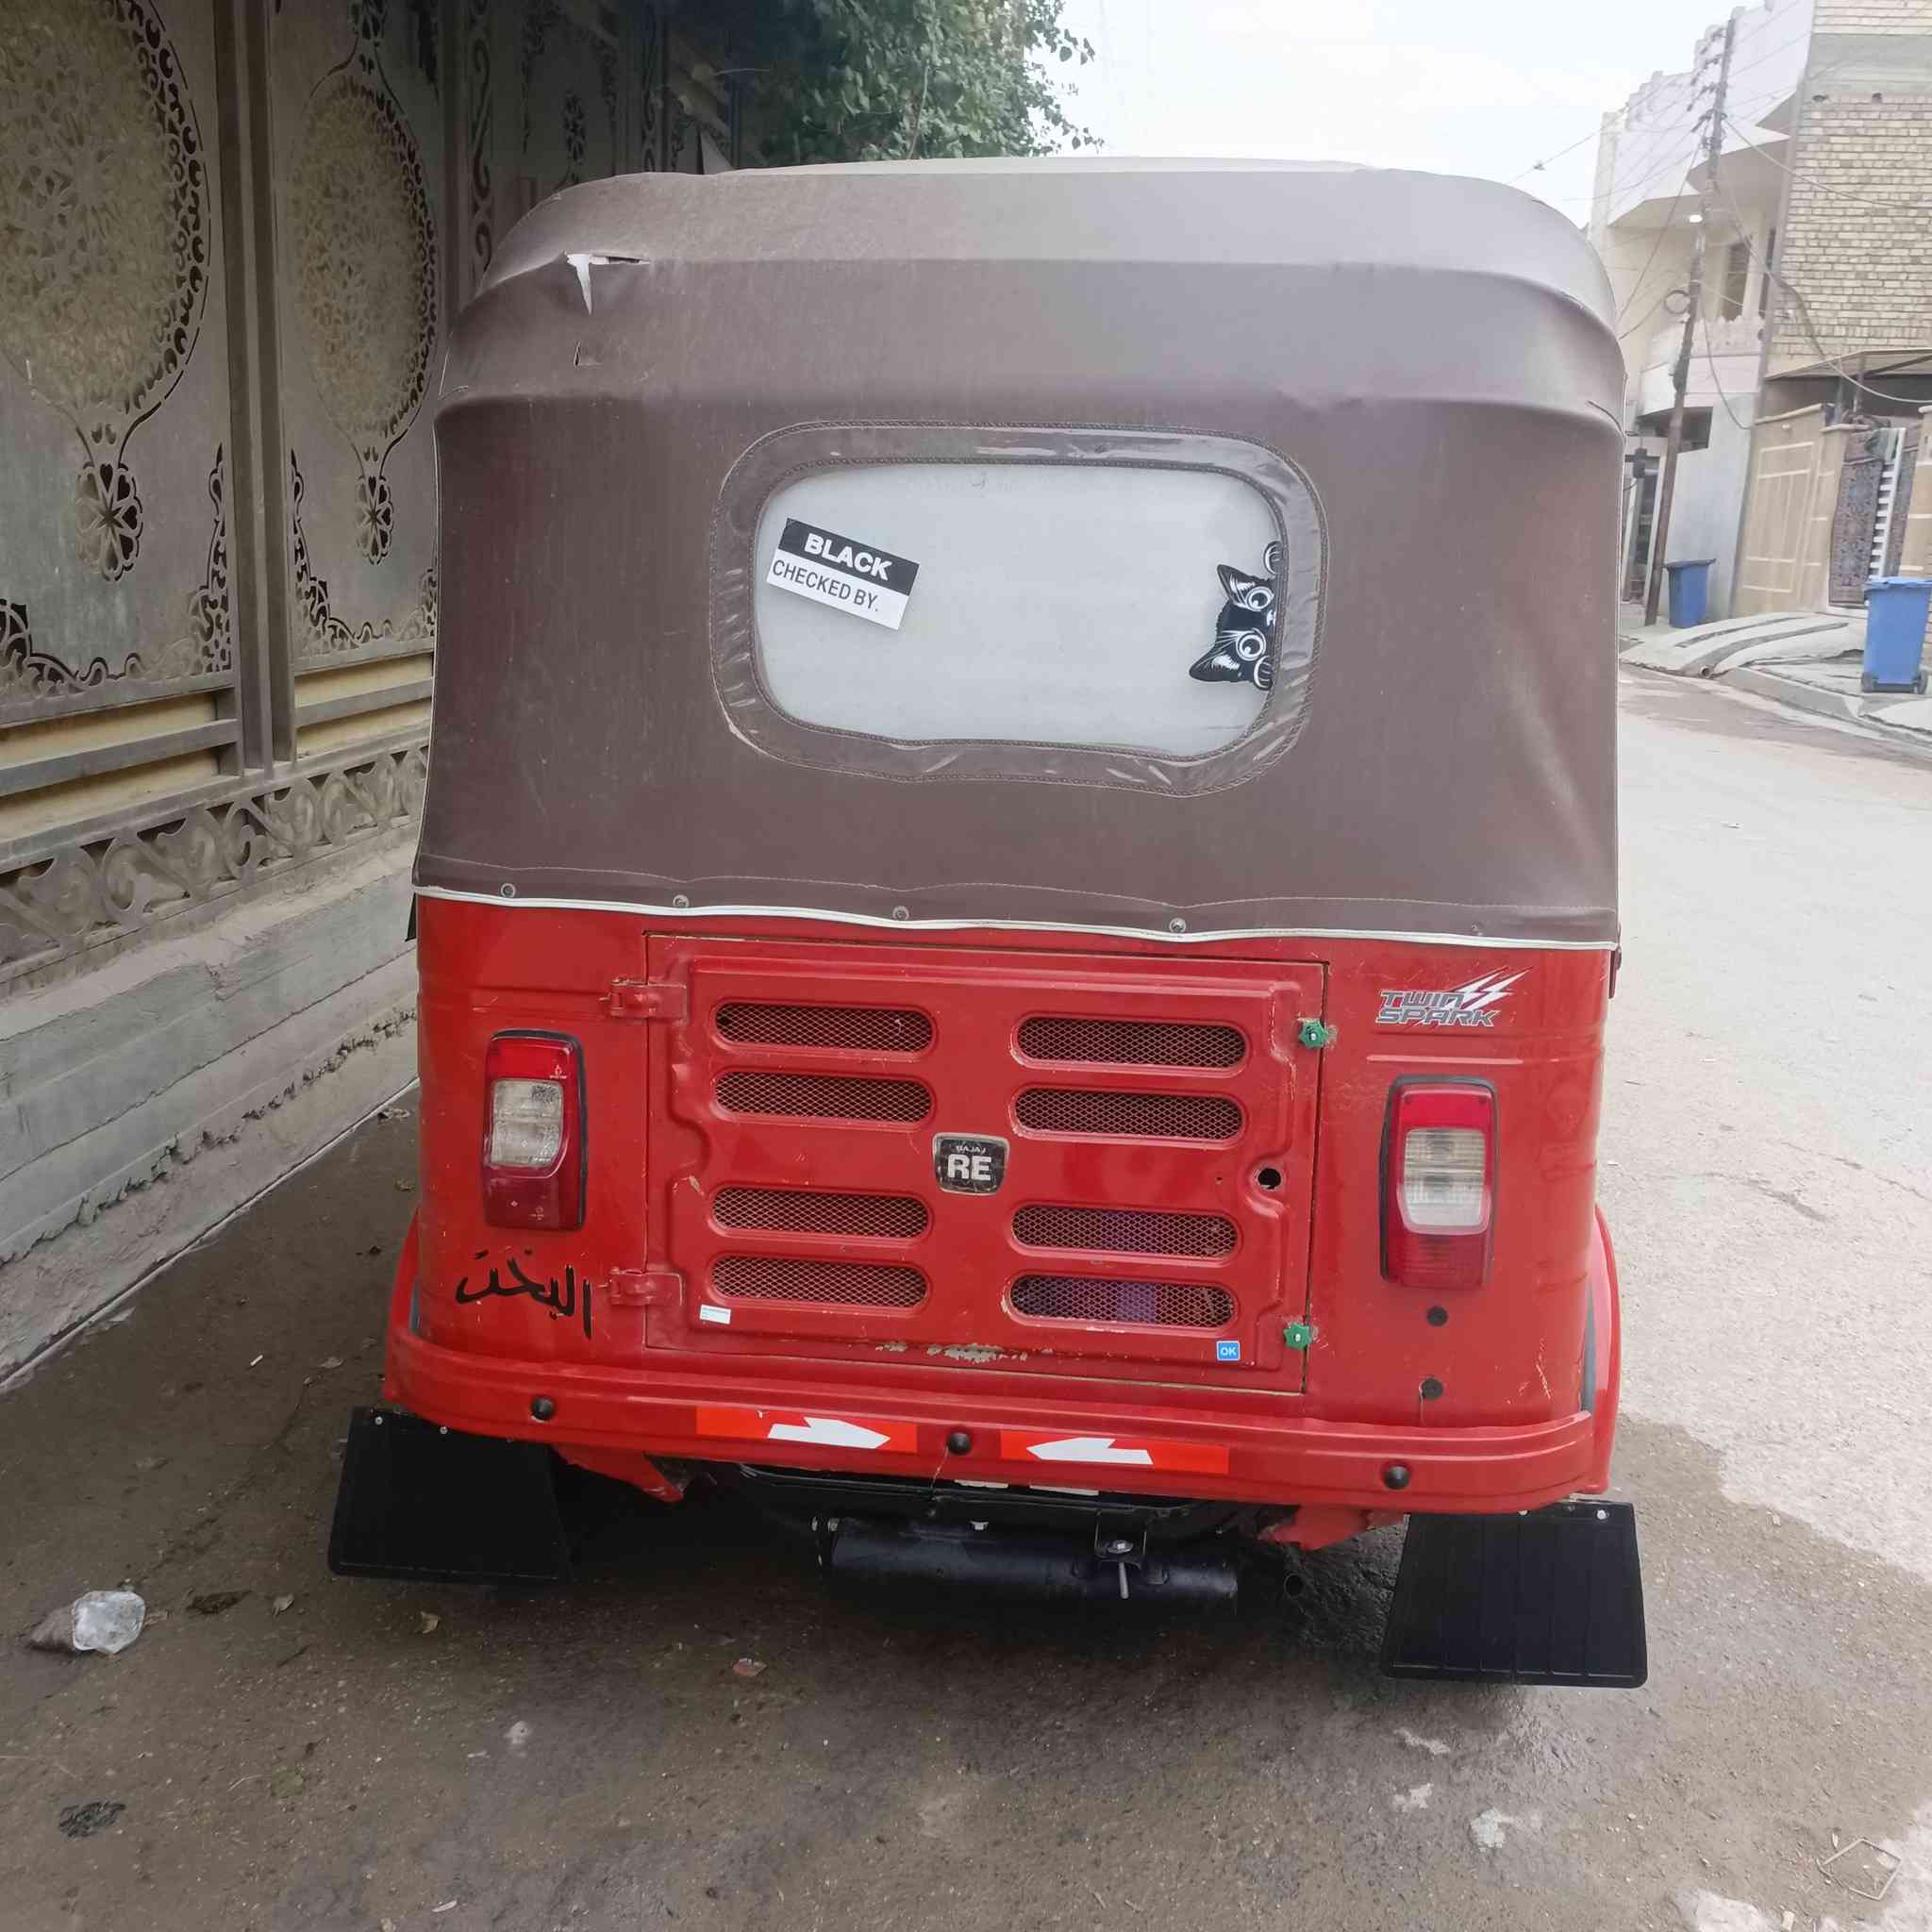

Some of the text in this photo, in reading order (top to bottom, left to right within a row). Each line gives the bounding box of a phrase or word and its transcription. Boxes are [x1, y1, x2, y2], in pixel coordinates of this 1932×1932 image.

[804, 532, 892, 581] BLACK
[772, 559, 879, 612] CHECKED BY.
[1379, 990, 1465, 1008] TWIN
[1375, 1008, 1501, 1027] SPARK
[947, 1154, 992, 1181] RE
[1220, 1346, 1237, 1357] OK
